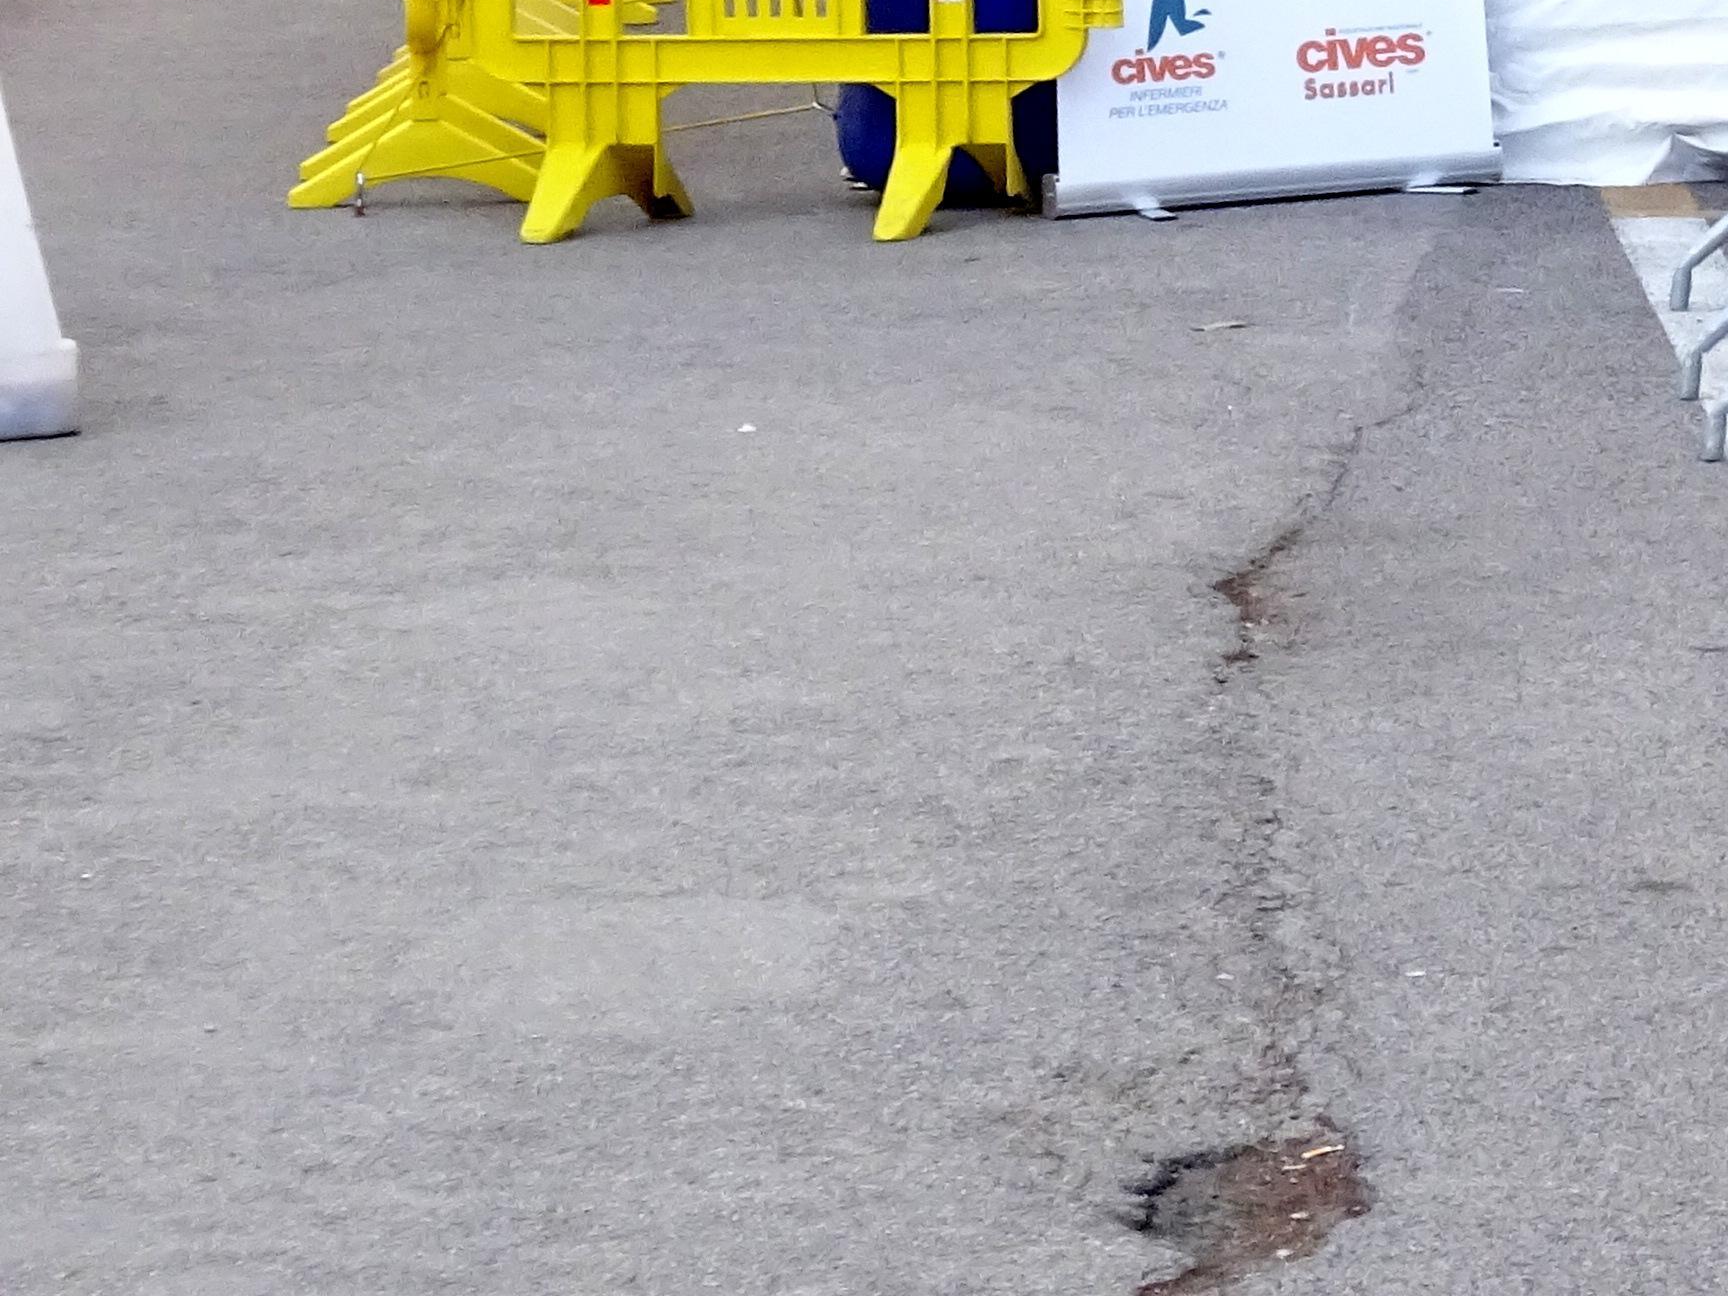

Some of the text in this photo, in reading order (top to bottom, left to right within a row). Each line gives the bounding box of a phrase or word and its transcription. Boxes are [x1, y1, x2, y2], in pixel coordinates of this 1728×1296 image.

[1295, 27, 1427, 74] cives
[1110, 47, 1216, 86] cives
[1129, 85, 1203, 103] INFERMIERI
[1304, 70, 1395, 101] Sassari
[1108, 105, 1136, 120] PER
